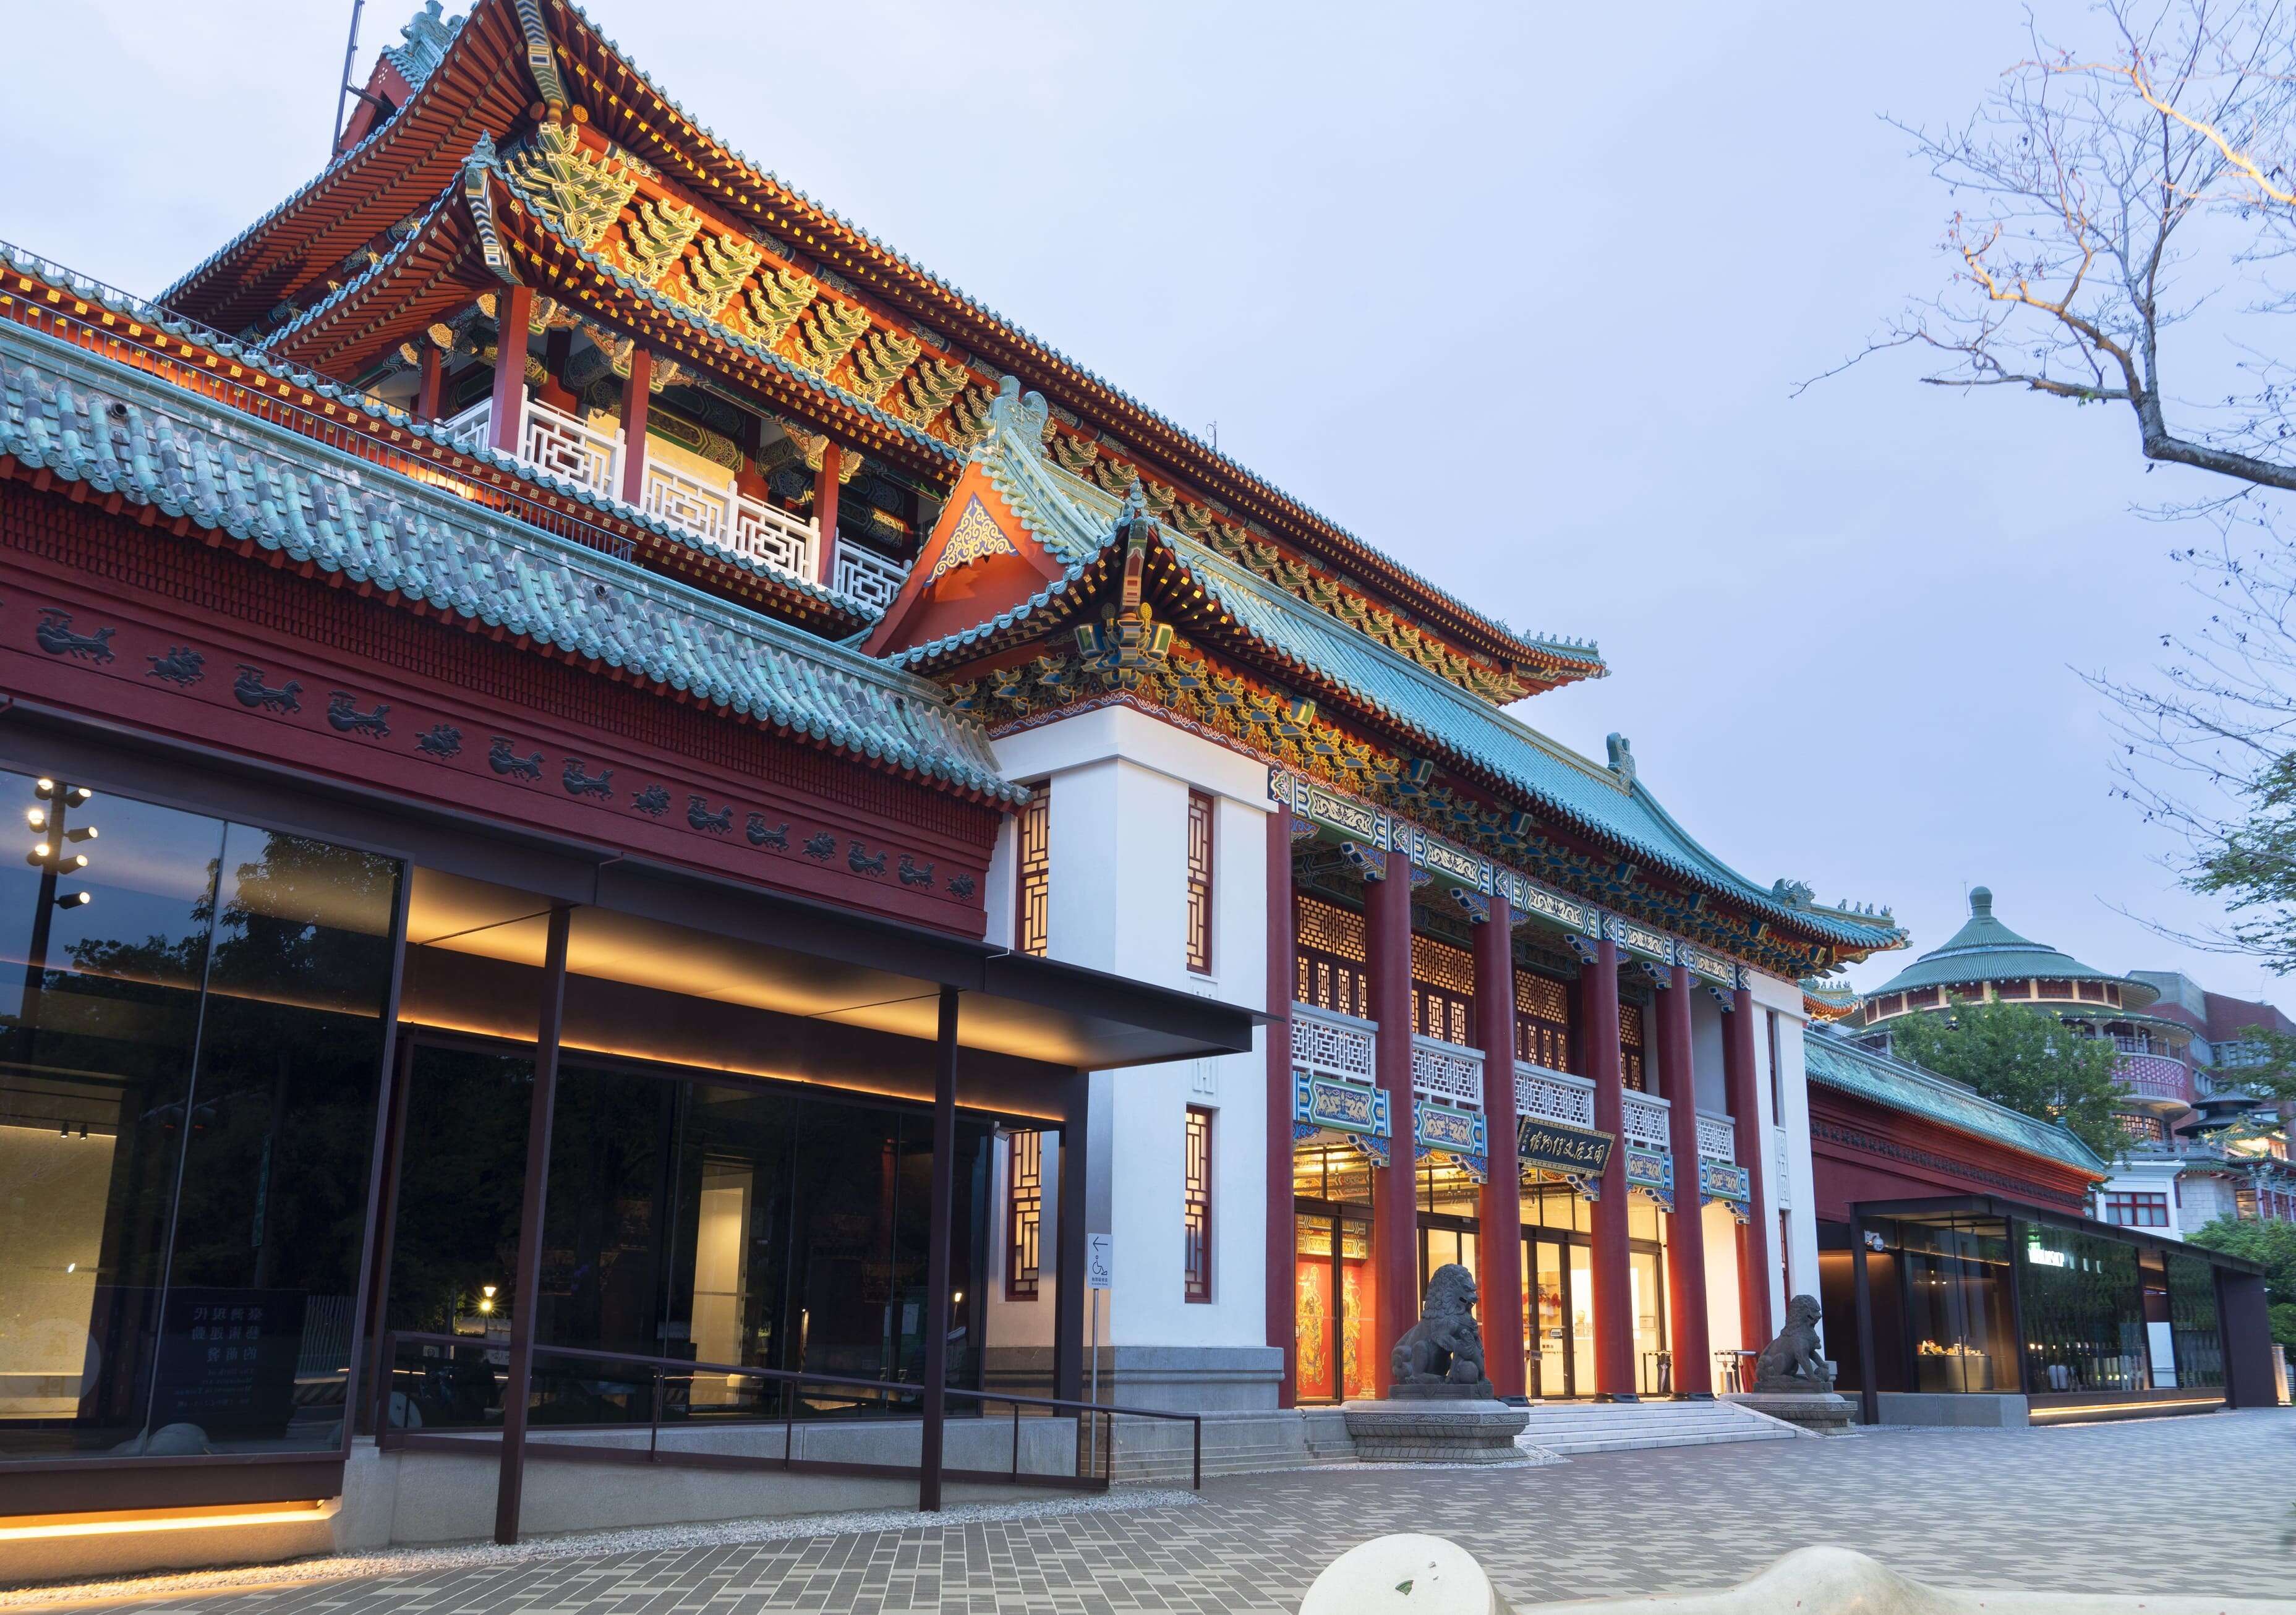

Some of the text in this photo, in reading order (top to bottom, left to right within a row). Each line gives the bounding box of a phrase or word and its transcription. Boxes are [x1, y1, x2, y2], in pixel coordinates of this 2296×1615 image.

[1529, 1130, 1605, 1164] 國立歷史博物館
